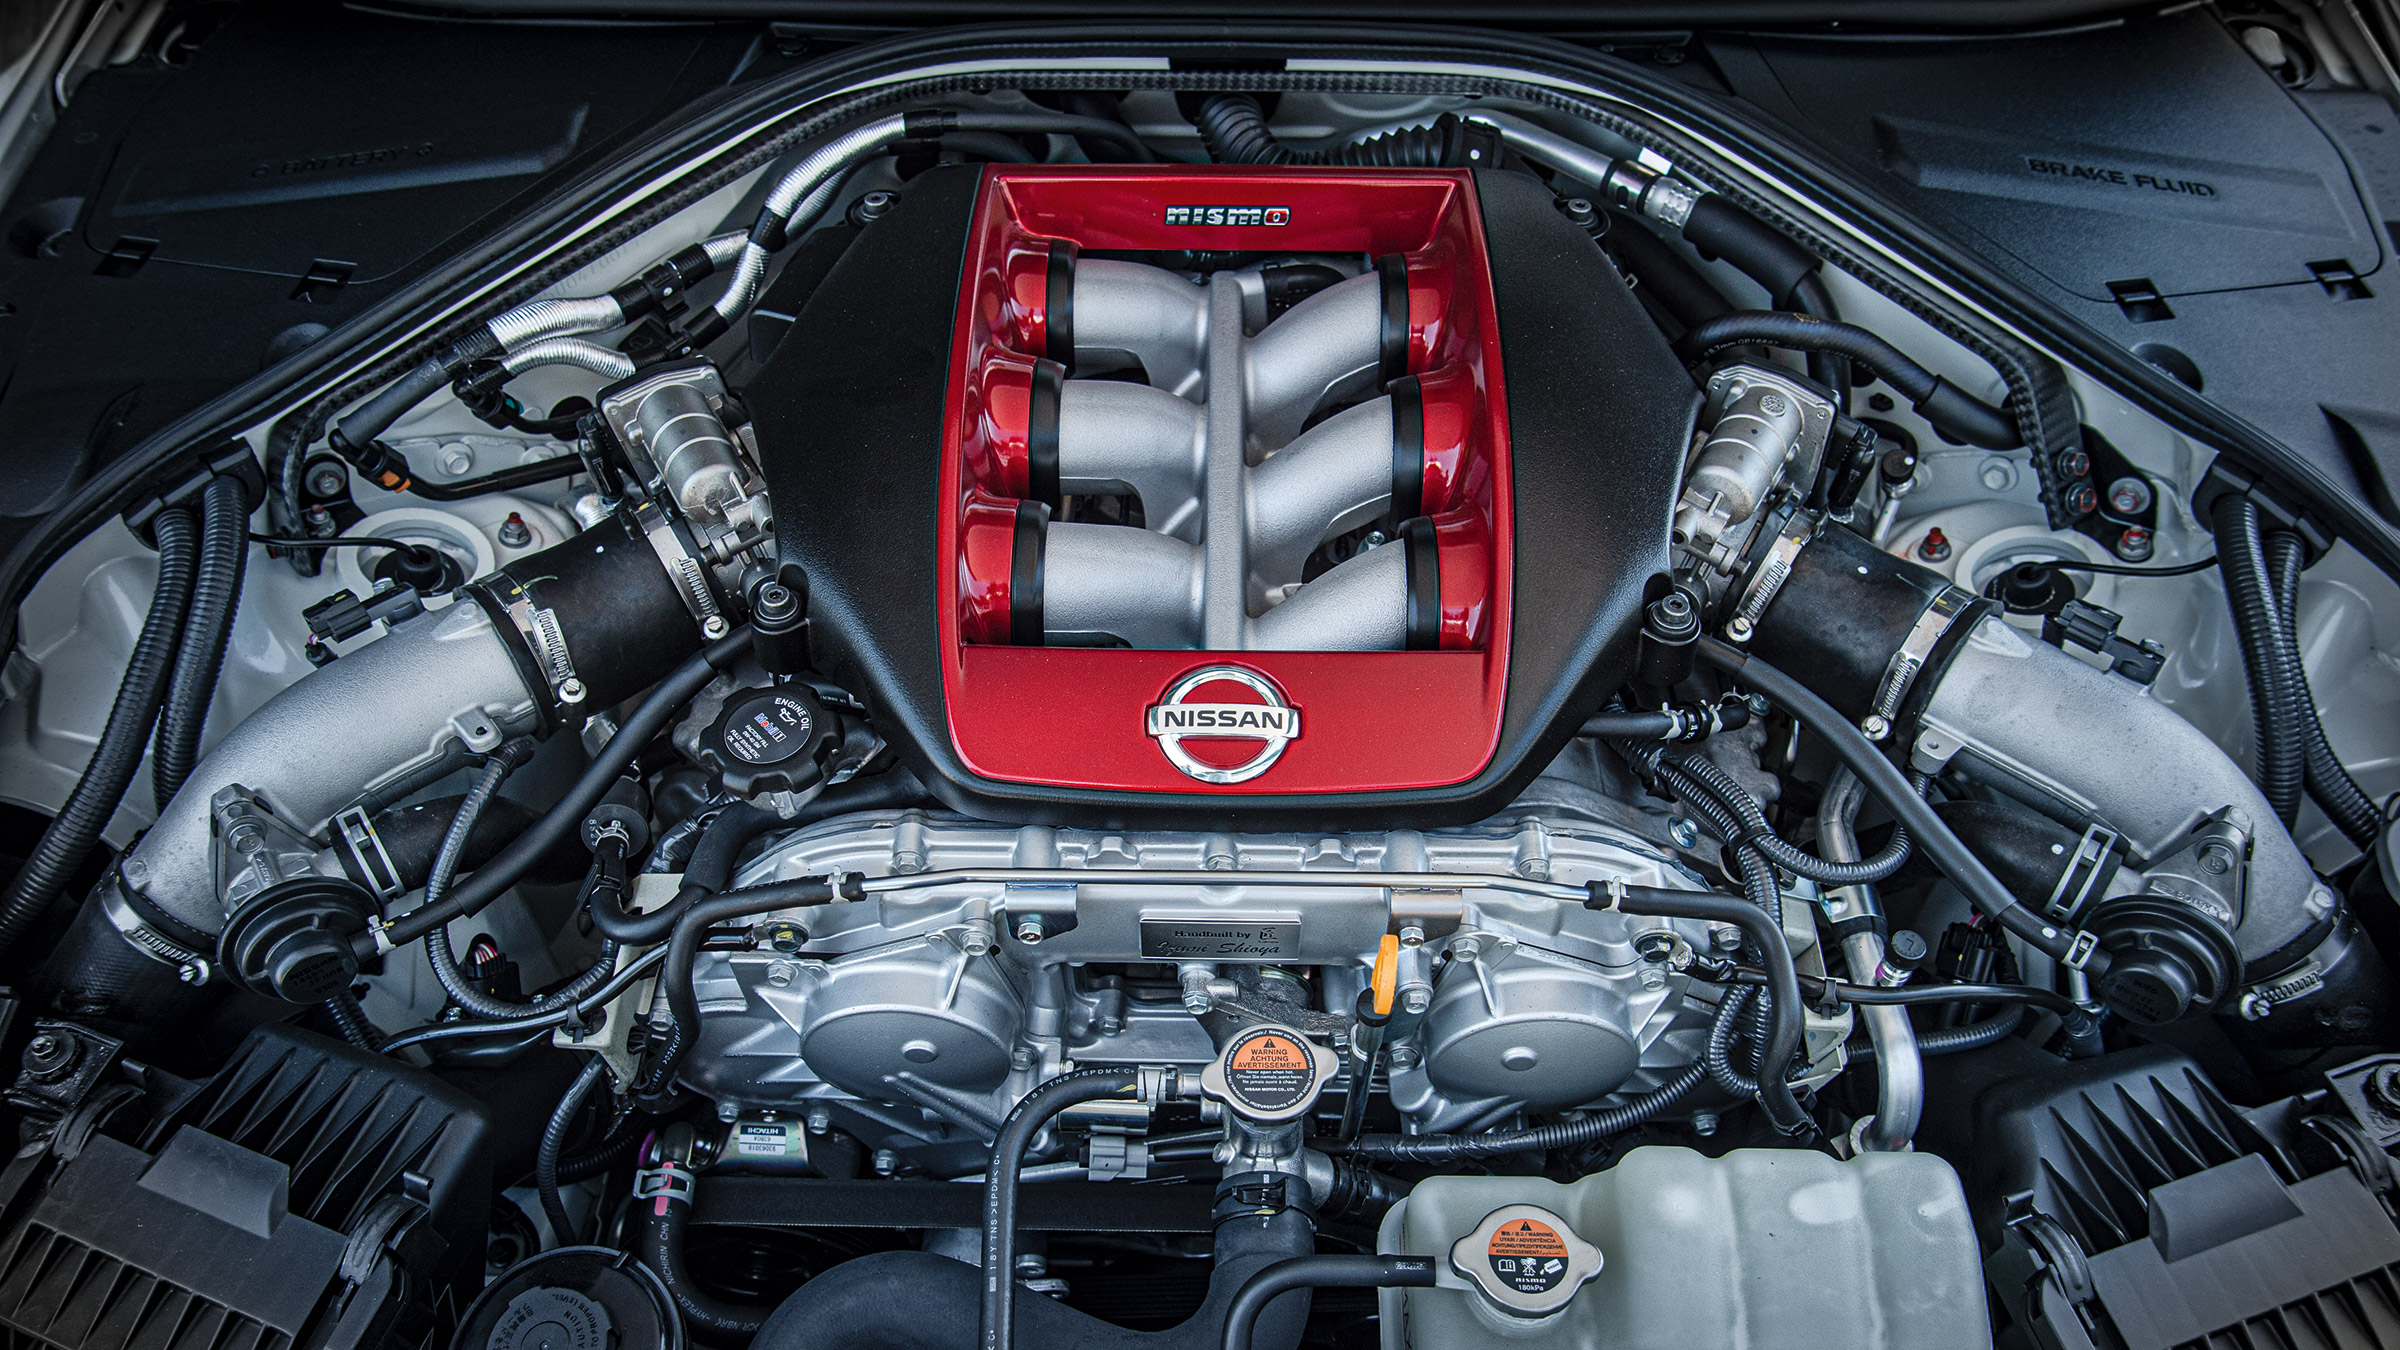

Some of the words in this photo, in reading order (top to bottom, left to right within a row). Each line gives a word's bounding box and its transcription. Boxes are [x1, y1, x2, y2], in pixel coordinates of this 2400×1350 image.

[281, 145, 408, 175] BATTERY
[2028, 158, 2128, 185] BRAKE
[2134, 173, 2216, 197] FLUID
[1166, 208, 1290, 226] nismo
[754, 712, 779, 736] Mobil
[774, 697, 807, 720] ENGINE
[800, 717, 810, 731] OIL
[1164, 710, 1283, 729] NISSAN
[745, 724, 762, 741] FACTORY
[733, 741, 752, 760] REQUIRED
[741, 738, 760, 759] SYNTHETIC
[1175, 930, 1233, 938] Handbuilt
[1237, 931, 1251, 939] by
[1216, 941, 1279, 956] Shioya
[1049, 1075, 1071, 1088] TNS
[1074, 1067, 1120, 1078] >EPDM<
[990, 1170, 999, 1215] >EPDM<
[660, 1221, 670, 1241] CHN
[990, 1219, 998, 1241] TNS
[660, 1245, 676, 1285] NICHIRIN
[578, 1302, 599, 1335] PROPER
